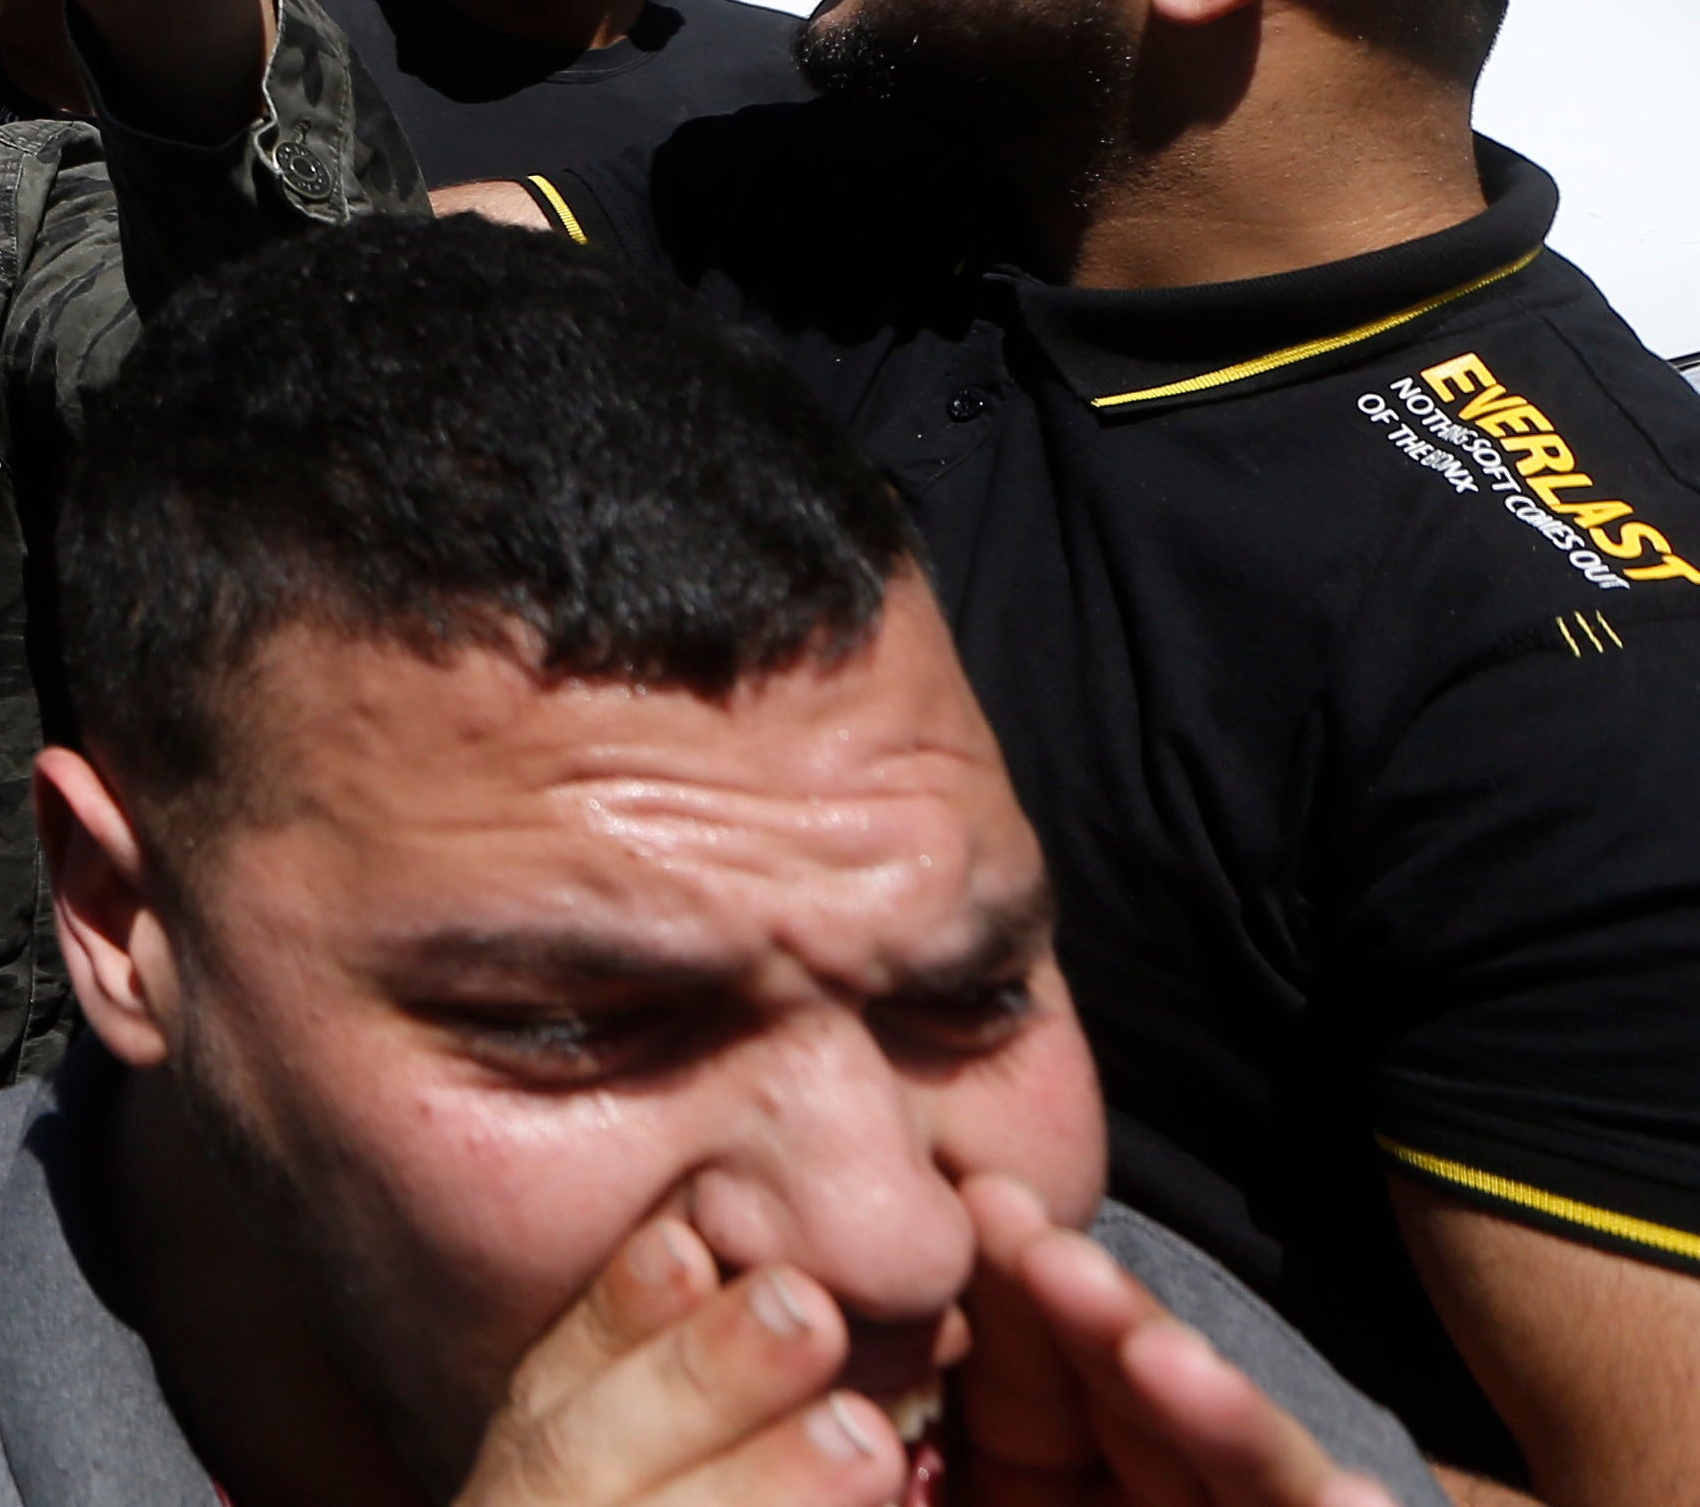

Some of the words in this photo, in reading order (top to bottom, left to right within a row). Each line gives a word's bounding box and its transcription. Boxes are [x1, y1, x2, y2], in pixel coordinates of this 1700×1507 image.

[1357, 393, 1400, 424] OF
[1387, 423, 1435, 461] THE
[1419, 351, 1700, 586] EVERLAST
[1462, 430, 1522, 493] SOFT
[1504, 495, 1585, 551] COMES
[1569, 549, 1631, 589] OUT
